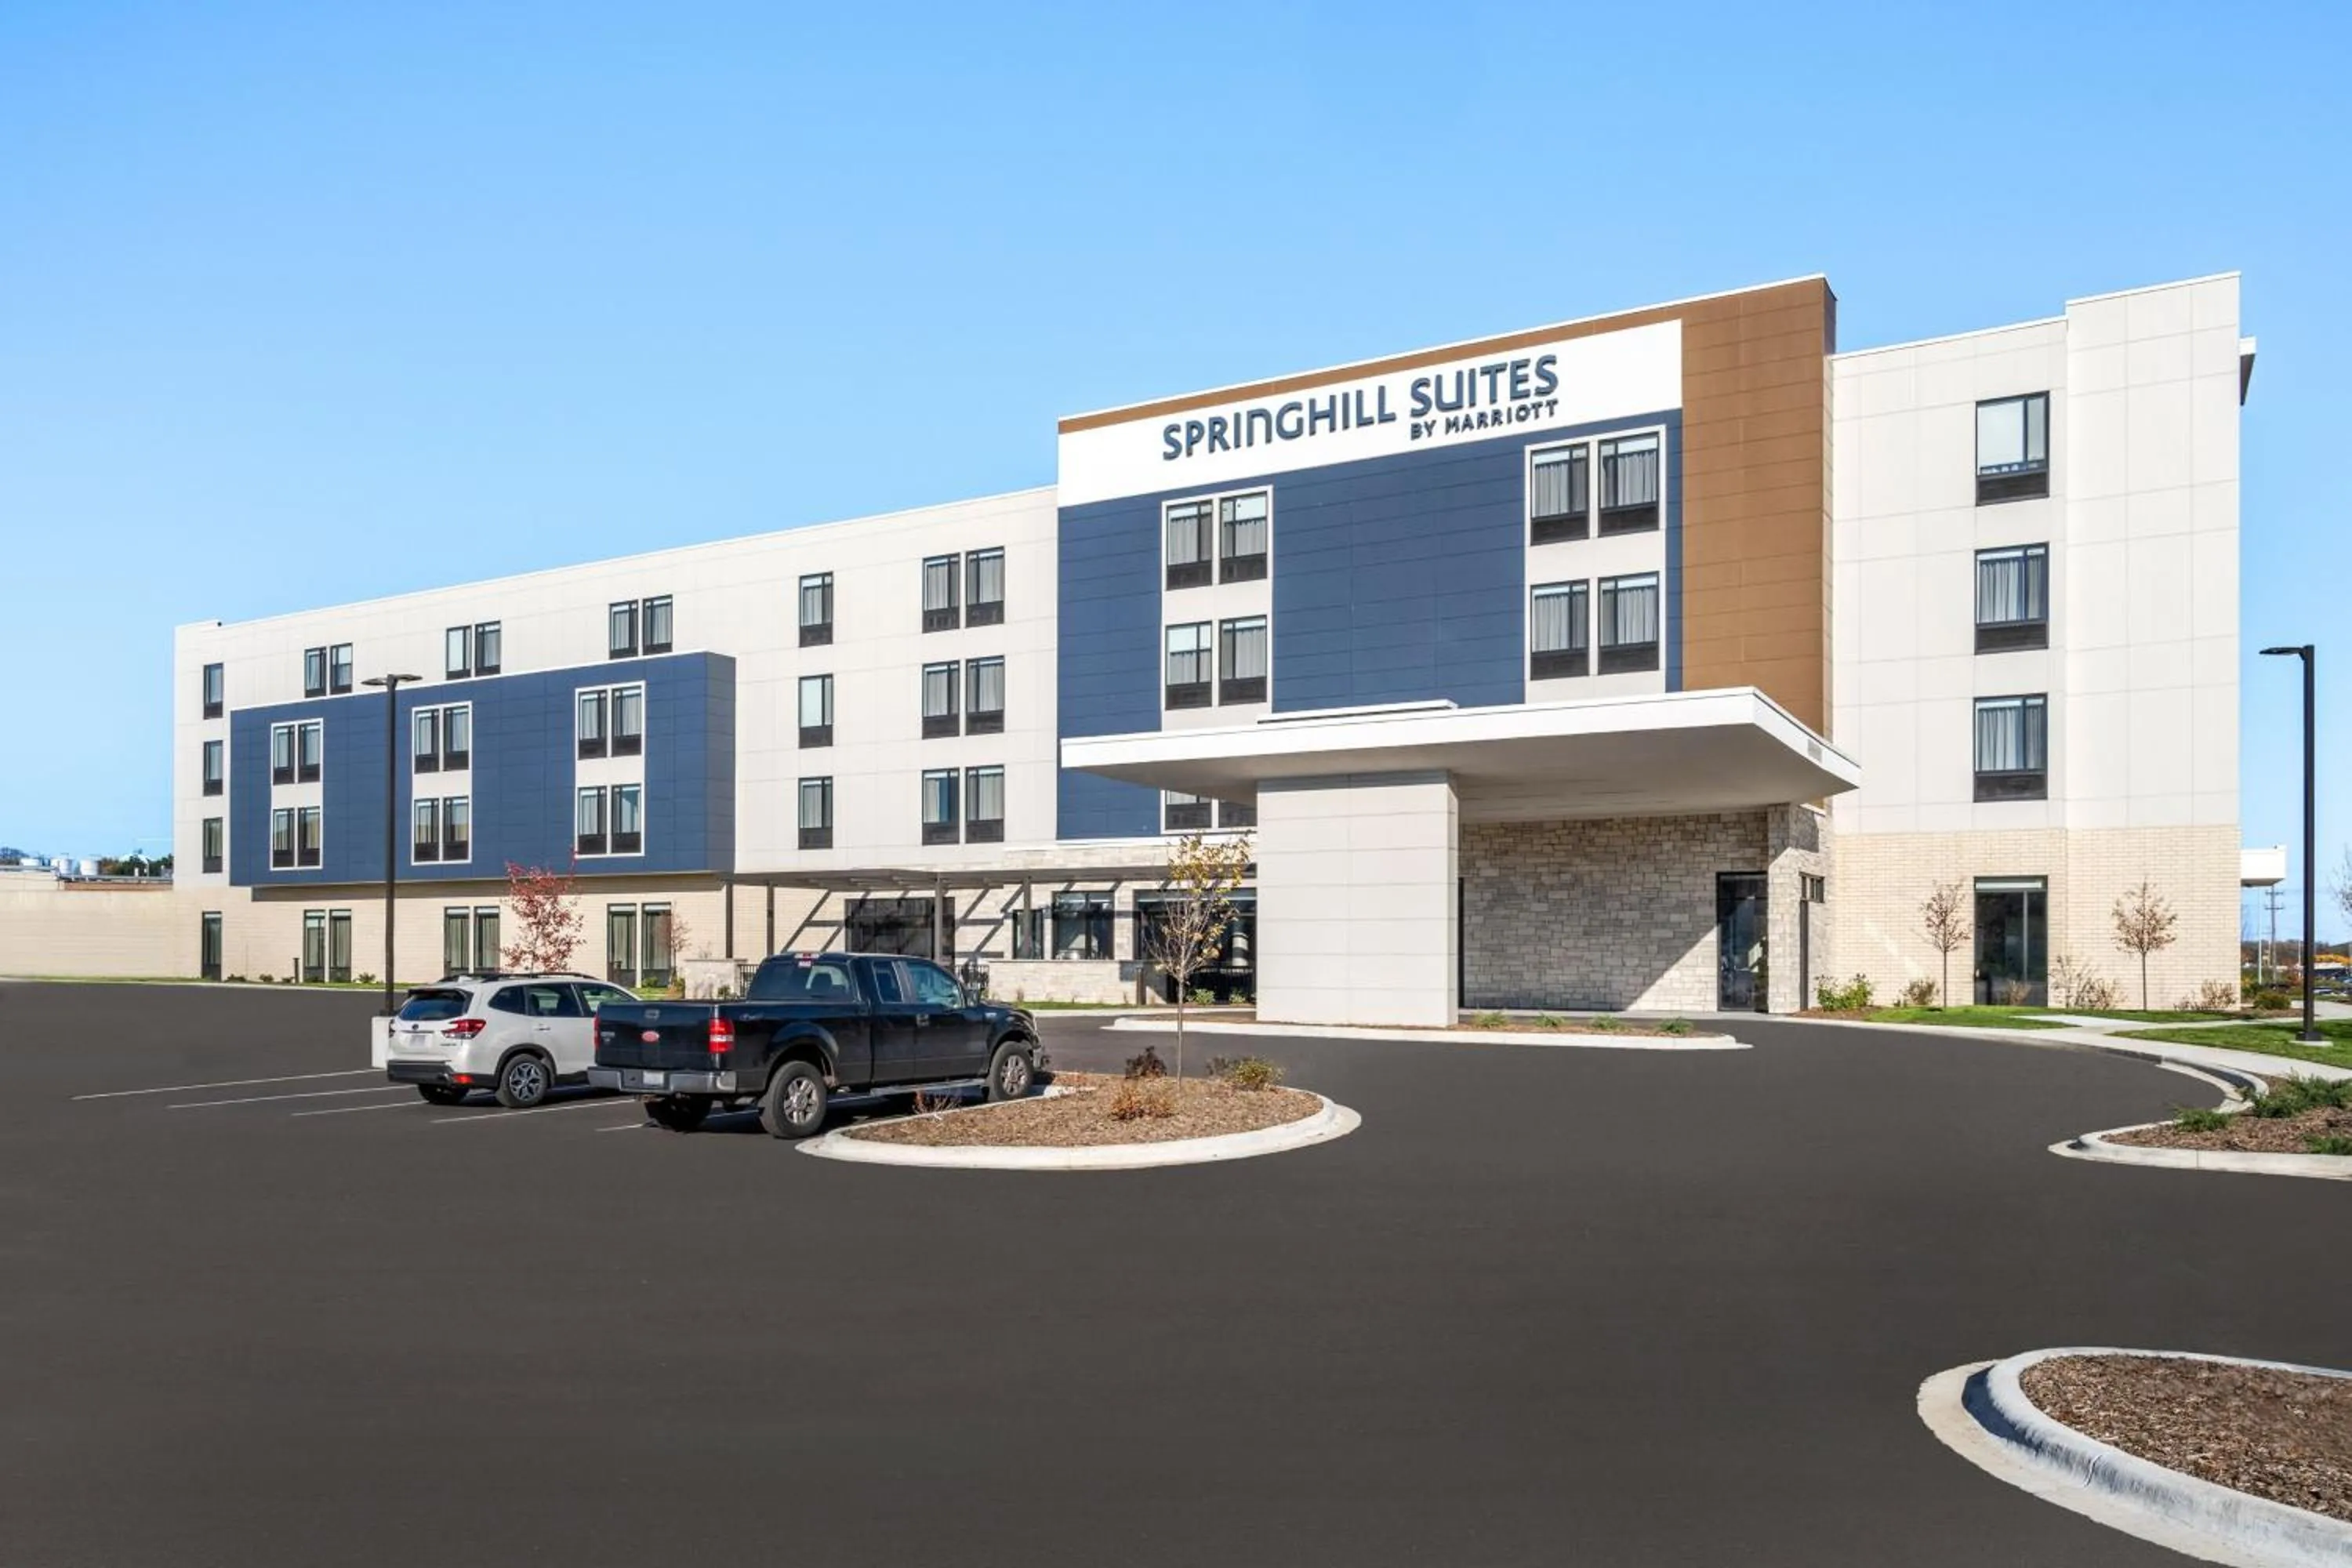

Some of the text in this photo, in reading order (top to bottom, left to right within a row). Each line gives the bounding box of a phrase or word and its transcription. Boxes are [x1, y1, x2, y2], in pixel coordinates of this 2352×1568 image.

[1163, 354, 1559, 461] SPRINGHILL SUITES
[1410, 397, 1559, 441] BY MARRIOTT
